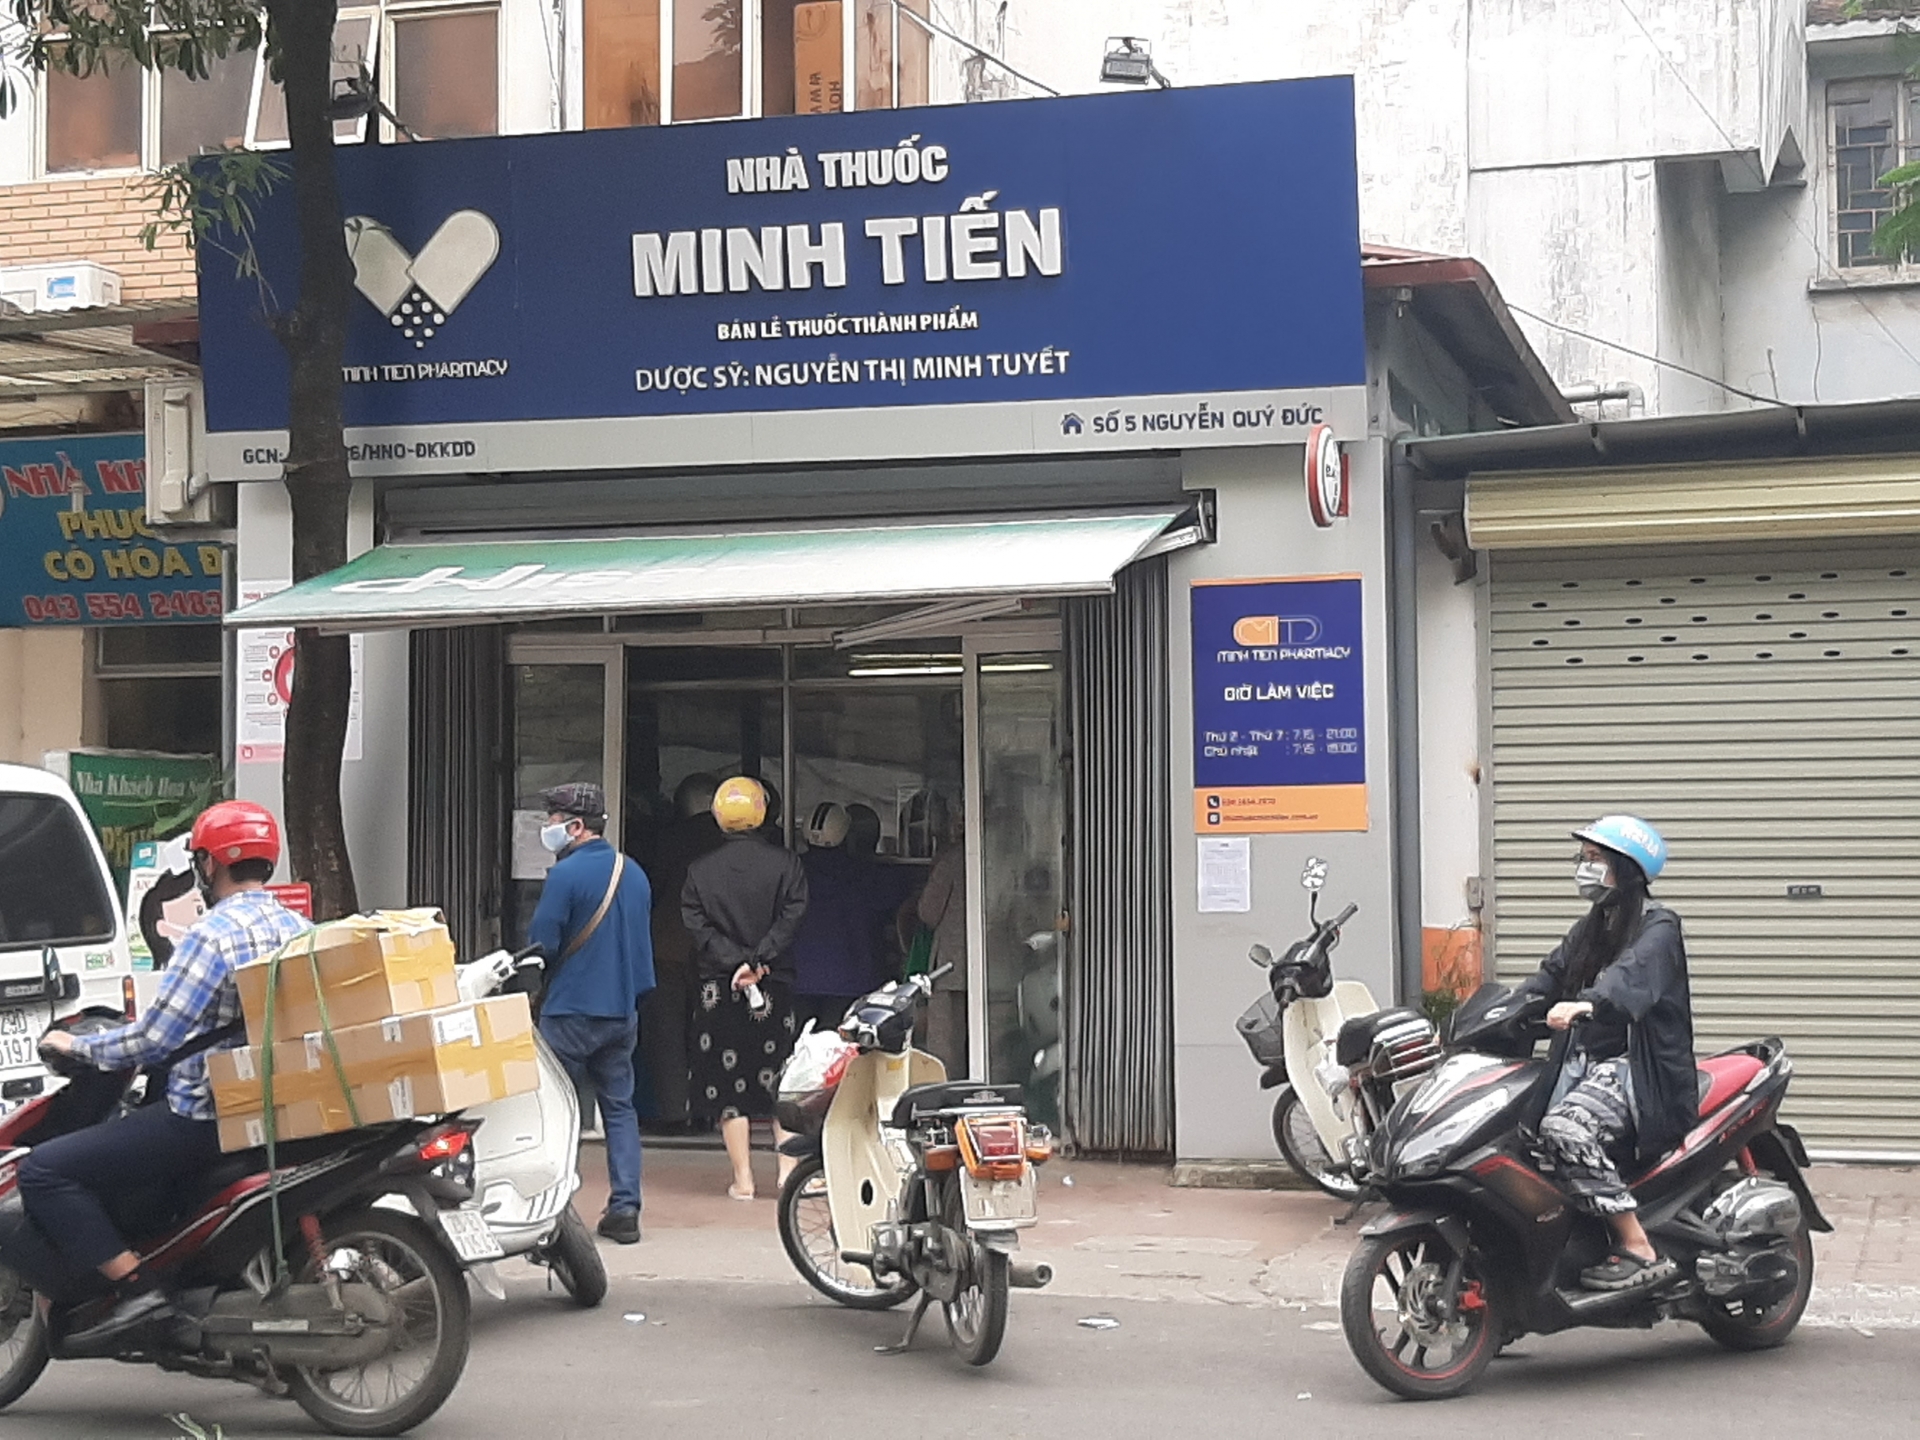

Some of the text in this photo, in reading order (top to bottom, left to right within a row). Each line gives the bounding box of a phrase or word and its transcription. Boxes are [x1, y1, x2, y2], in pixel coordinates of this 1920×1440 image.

[727, 134, 948, 193] NHÀ THUỐC
[632, 190, 1062, 297] MINH TIẾN
[786, 312, 849, 337] THUỐC
[851, 312, 917, 334] THÀNH
[418, 359, 508, 379] PHARMACY
[635, 365, 708, 395] DƯỢC
[755, 353, 859, 386] NGUYỄN
[864, 359, 906, 387] THỊ
[913, 355, 982, 379] MINH
[986, 345, 1070, 376] TUYẾT
[1092, 402, 1323, 433] SỐ 5 NGUYỄN QUÝ ĐỨC
[2, 451, 146, 498] NHÀ KH
[23, 595, 80, 622] 043
[85, 593, 144, 620] 554
